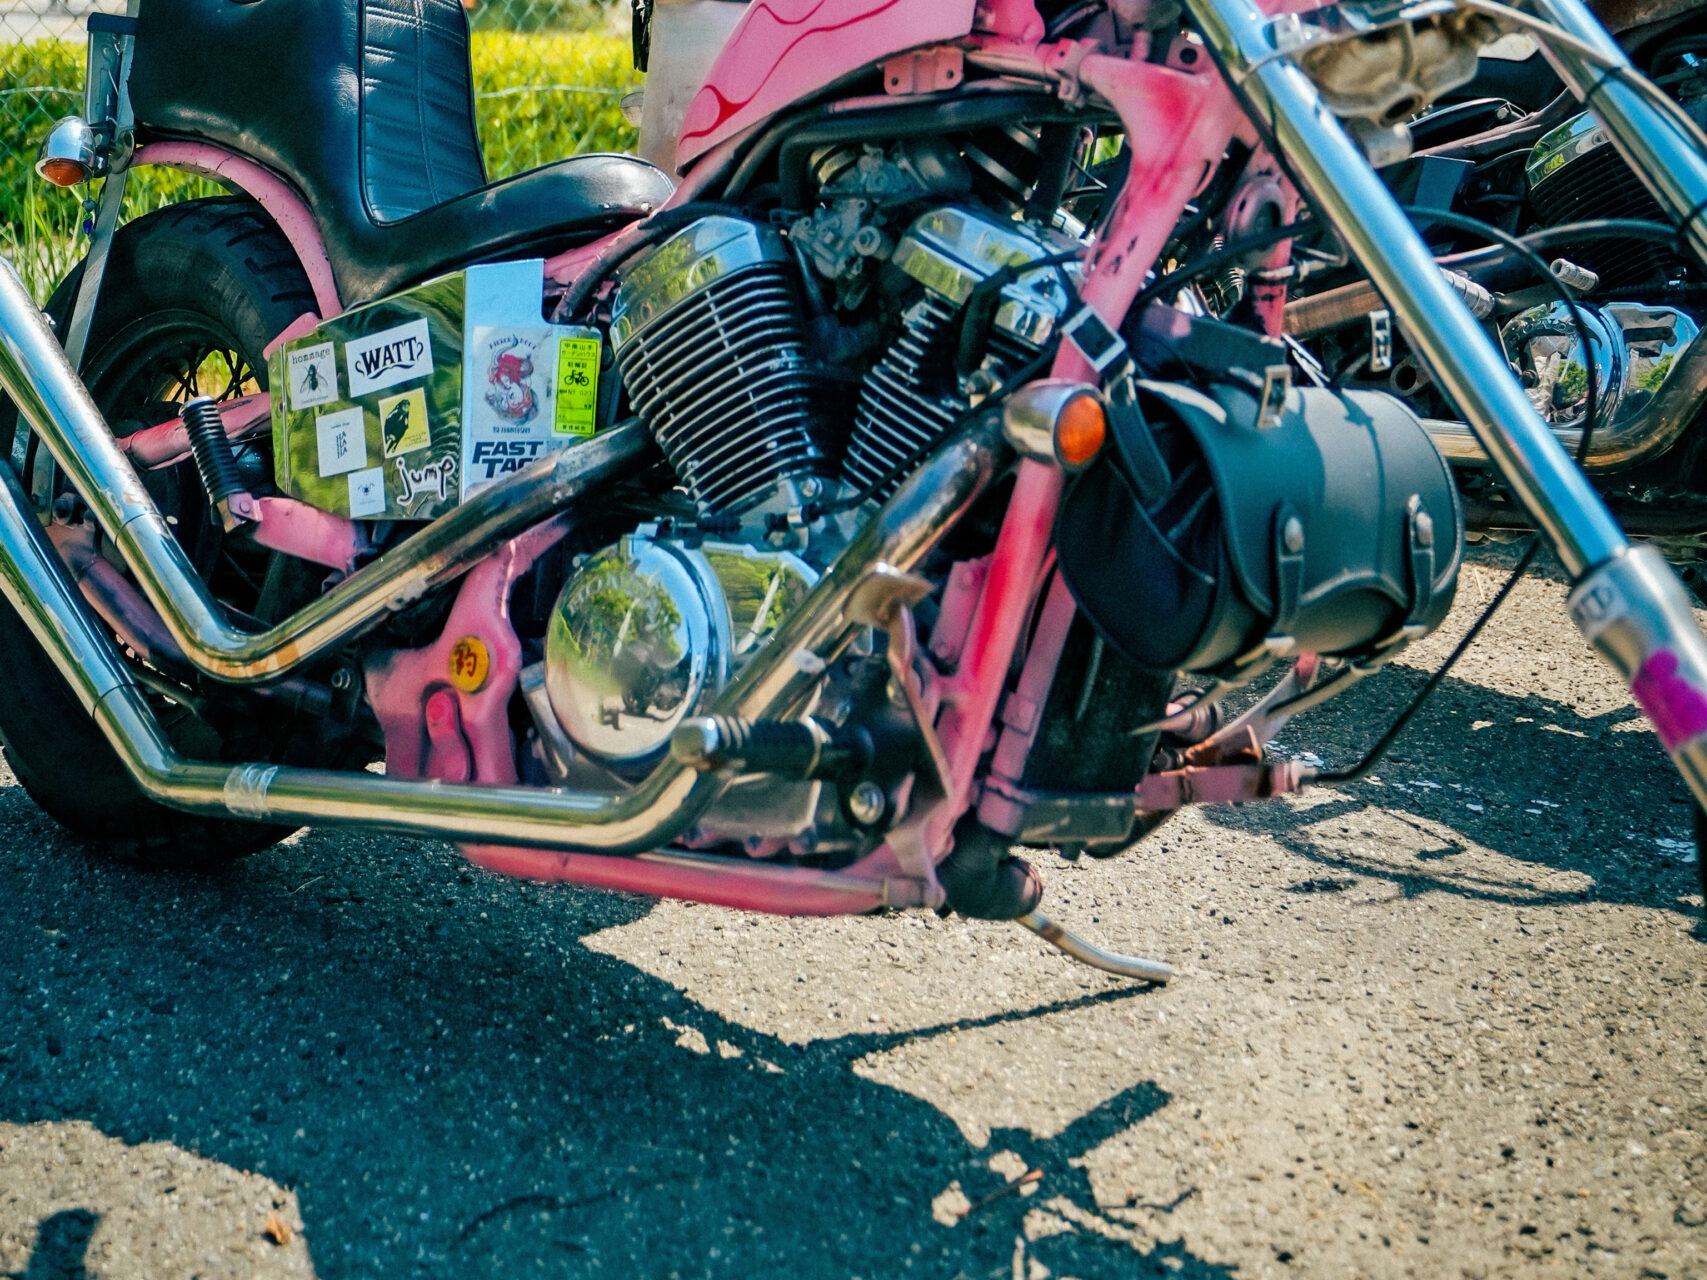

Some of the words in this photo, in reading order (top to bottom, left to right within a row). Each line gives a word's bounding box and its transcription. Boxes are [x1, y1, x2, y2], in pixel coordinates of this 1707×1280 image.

[292, 348, 330, 365] hommage
[360, 336, 417, 376] WATT
[472, 441, 544, 464] FAST
[481, 457, 540, 478] TAC
[398, 458, 454, 503] jump
